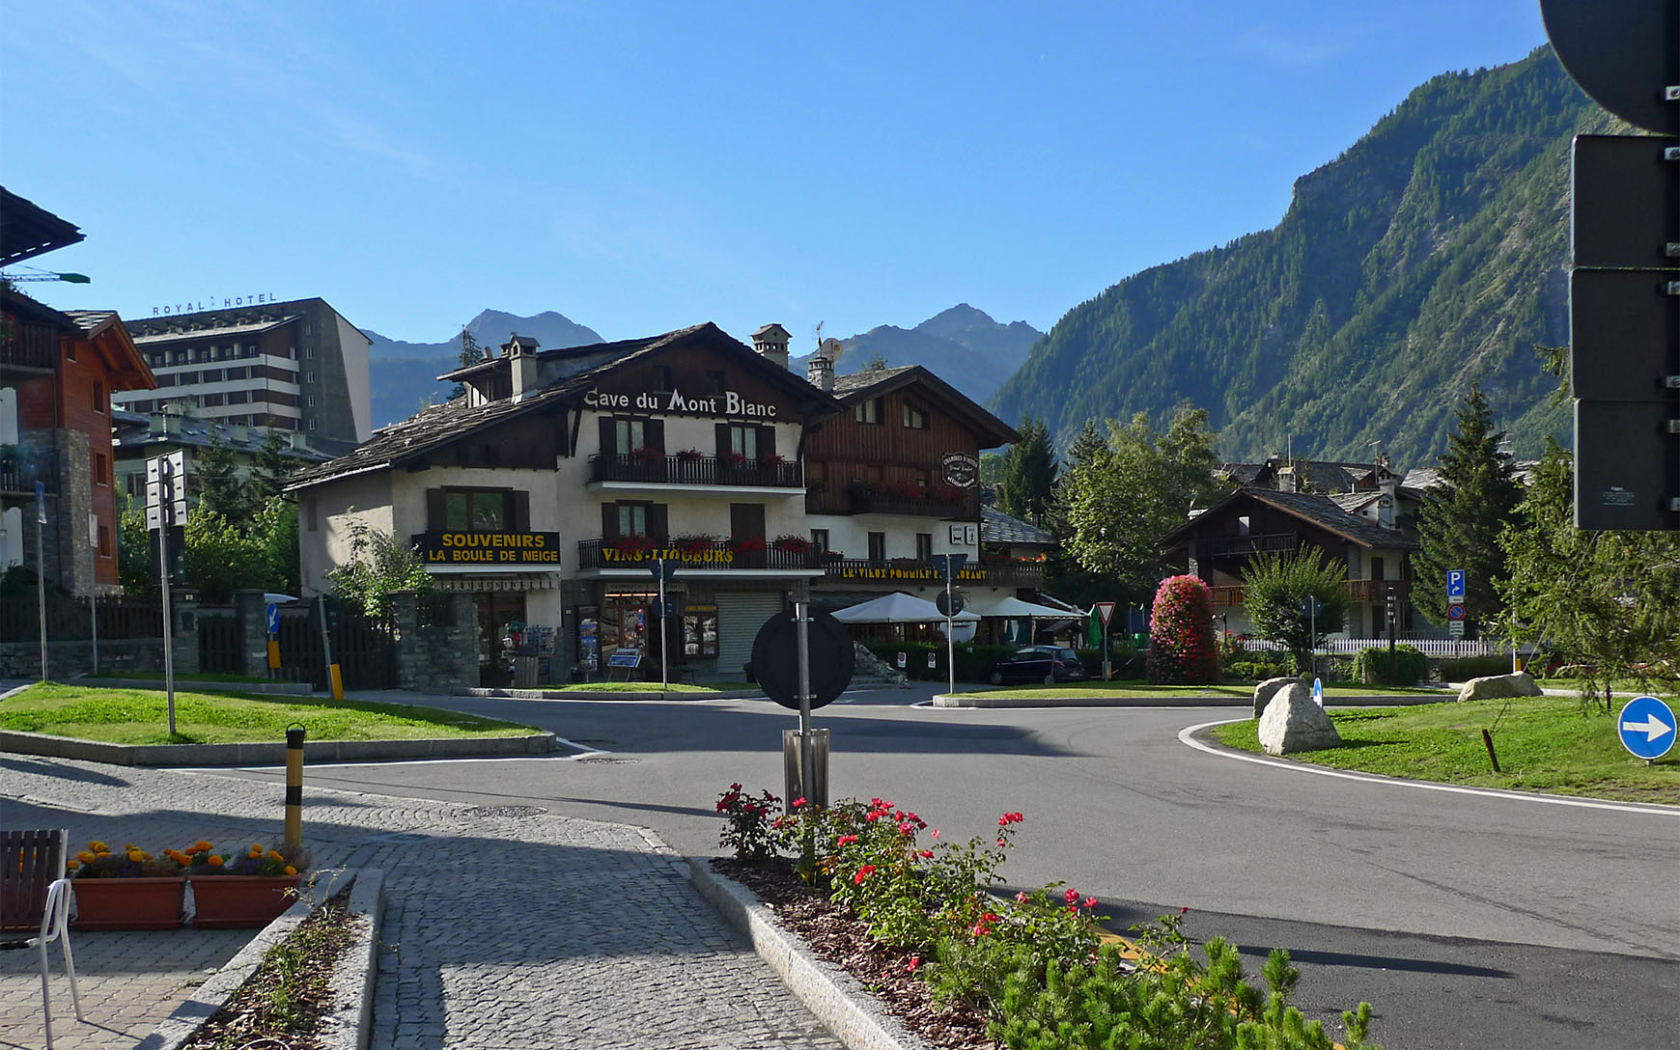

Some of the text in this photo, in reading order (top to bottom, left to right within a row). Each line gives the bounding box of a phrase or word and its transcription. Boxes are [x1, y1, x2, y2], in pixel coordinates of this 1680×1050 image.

[153, 293, 277, 316] ROYAL HOTEL
[584, 386, 777, 417] Cave du Mont Blanc
[442, 533, 545, 548] SOUVENIRS
[429, 550, 558, 562] LA BOULE DE NEIGE
[842, 568, 855, 578] LE
[858, 568, 887, 579] VIEUX
[889, 569, 930, 579] POMMIER
[1451, 572, 1461, 585] P
